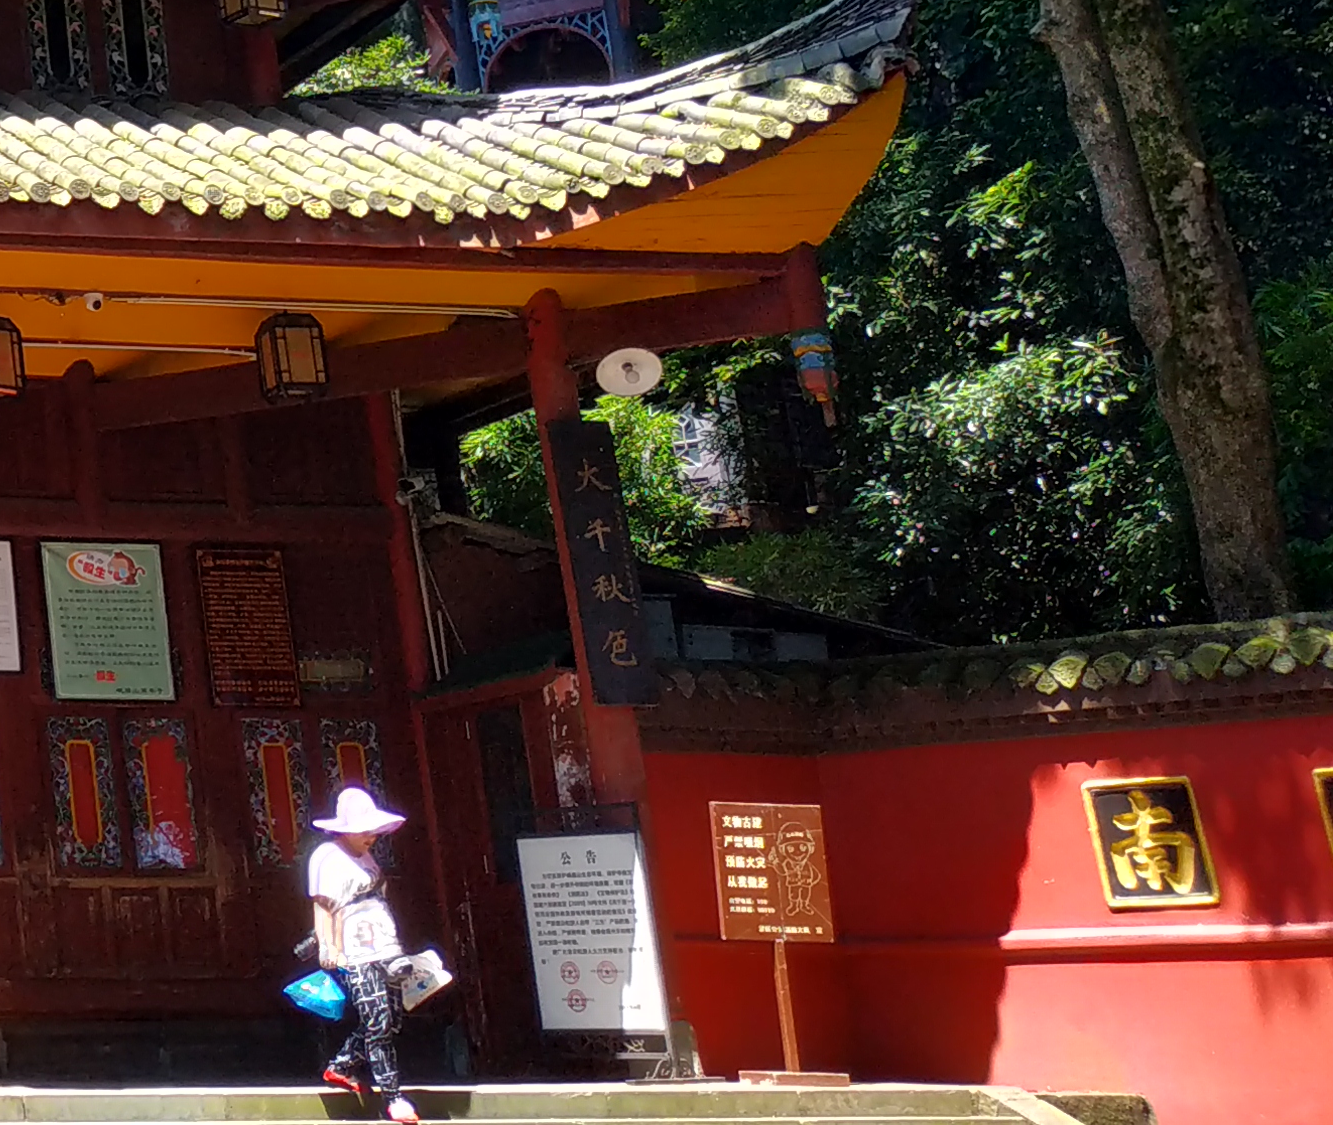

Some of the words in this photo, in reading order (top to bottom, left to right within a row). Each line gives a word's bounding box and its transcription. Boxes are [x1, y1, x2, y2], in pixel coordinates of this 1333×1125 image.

[574, 458, 638, 667] 大千秋色
[722, 815, 763, 829] 文物古建
[724, 835, 765, 849] 严禁吸烟
[1110, 789, 1196, 895] 南
[560, 849, 597, 865] 公告
